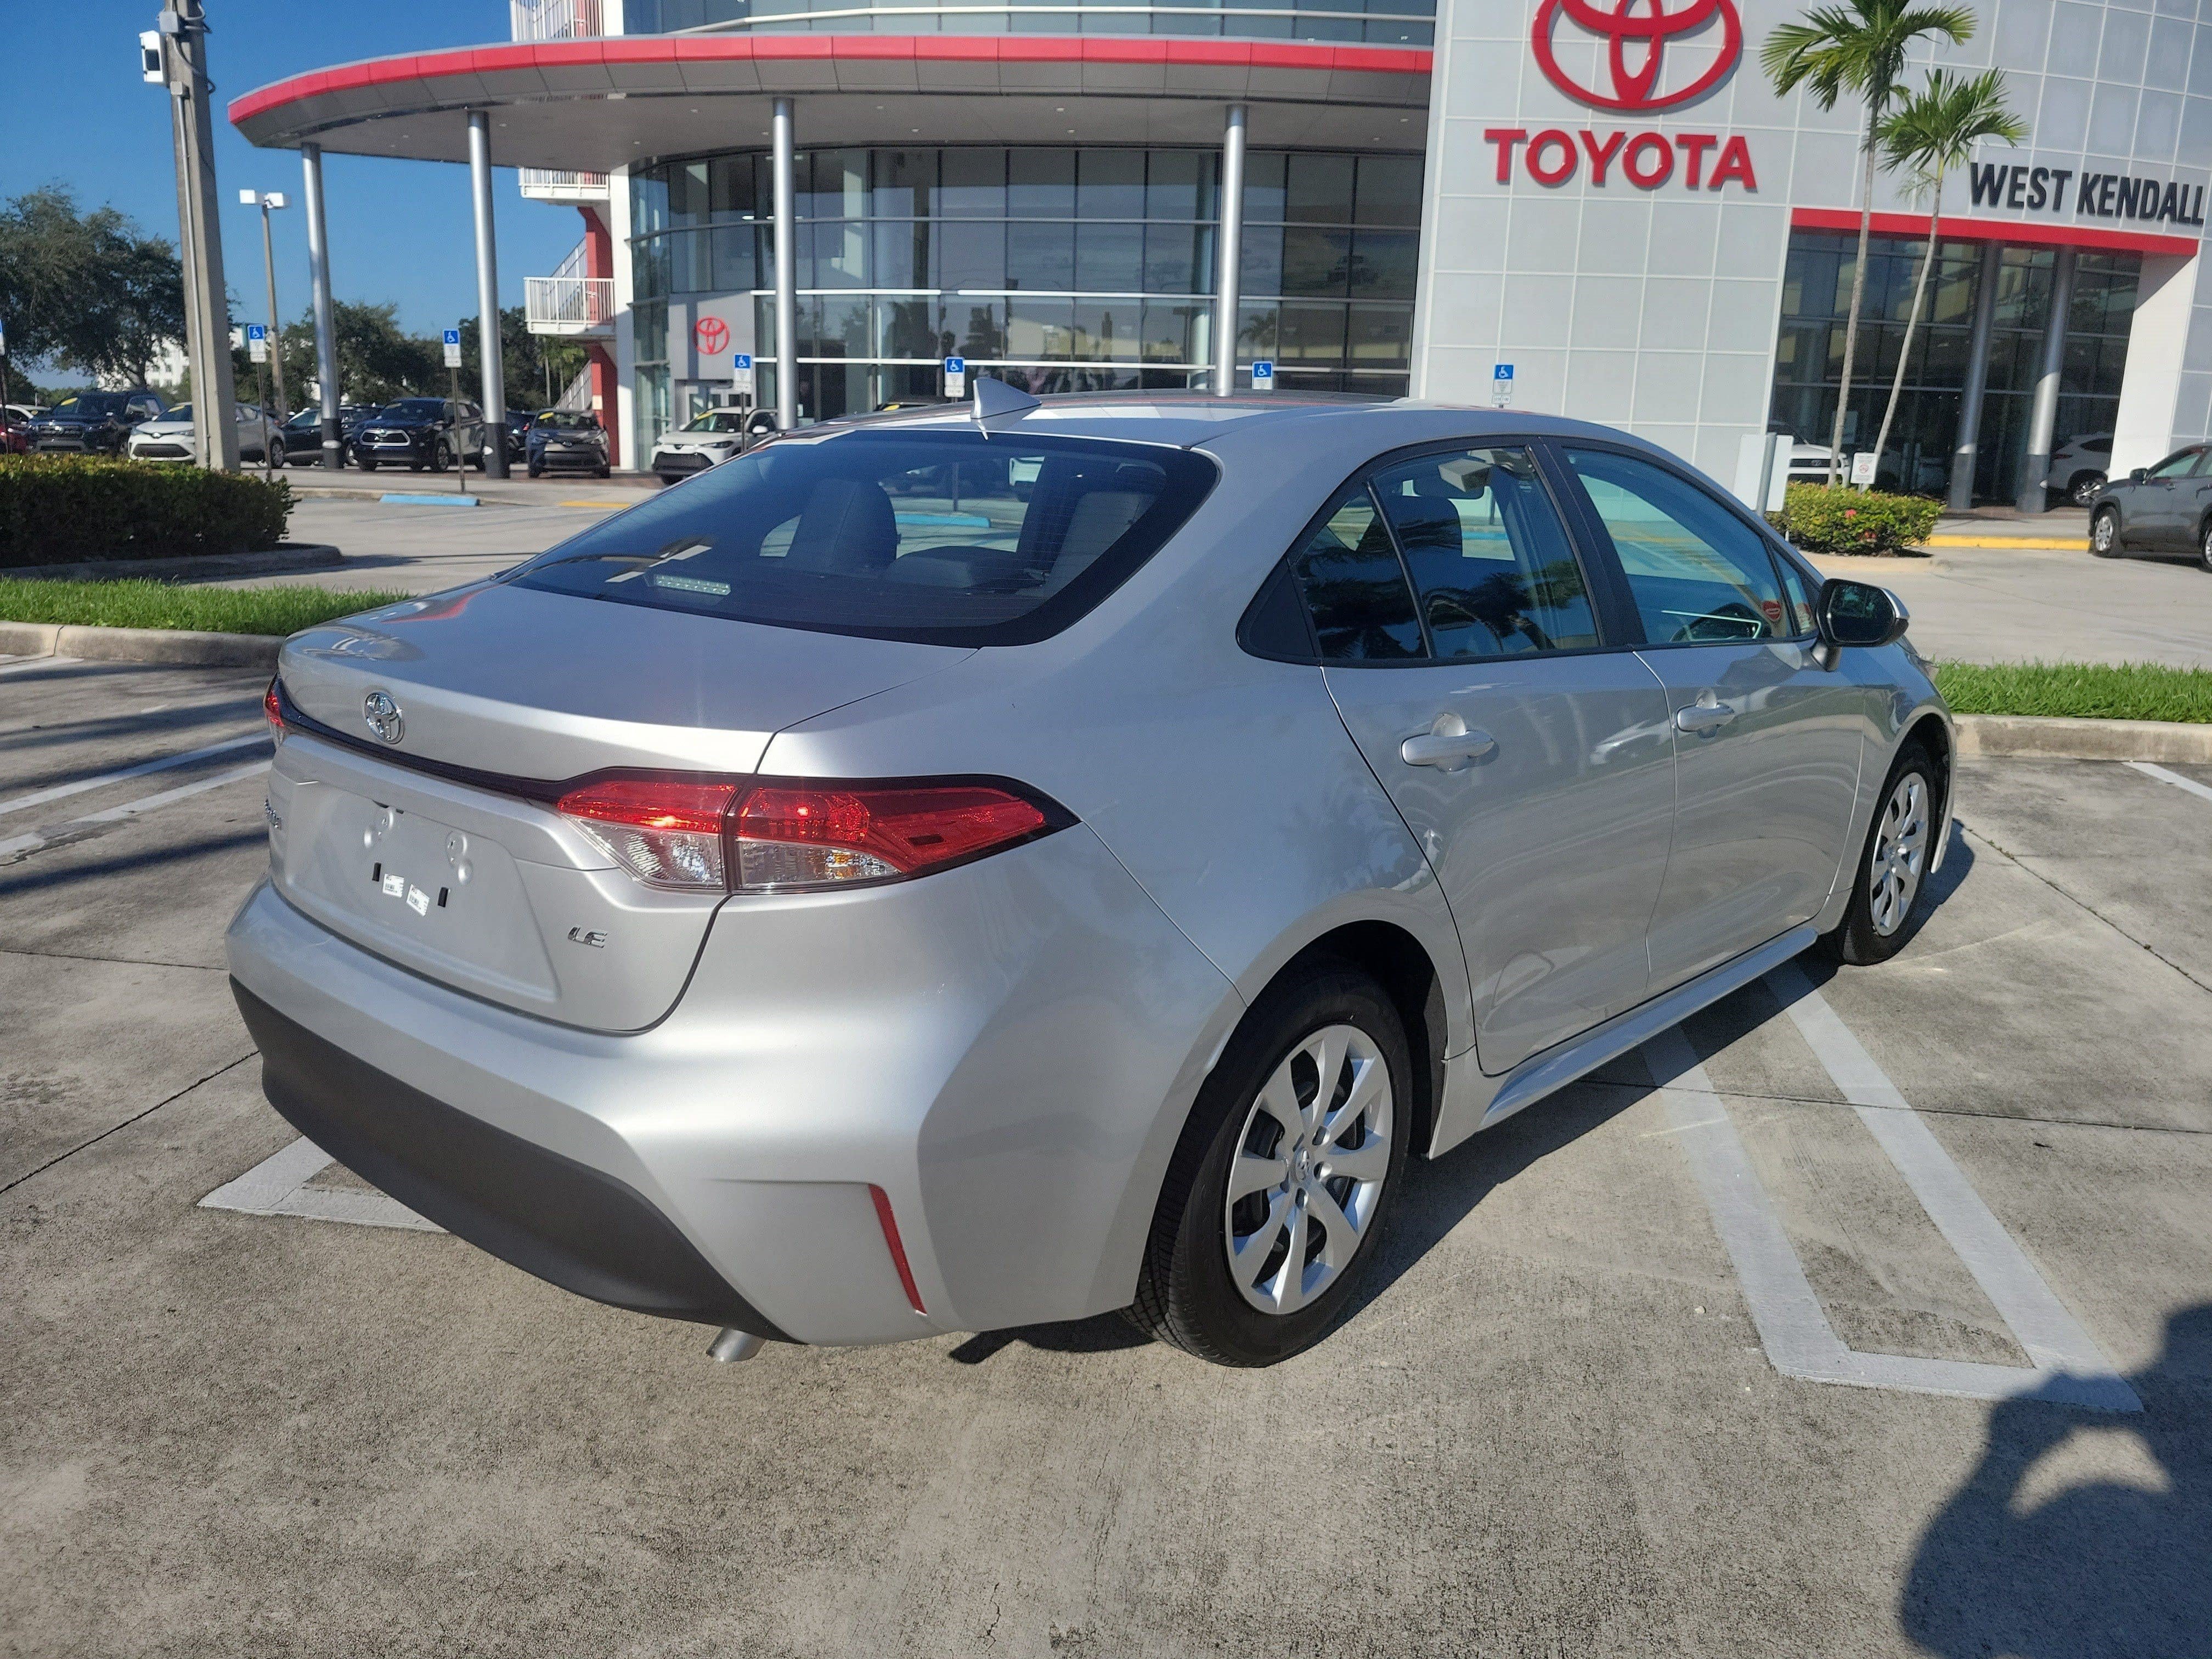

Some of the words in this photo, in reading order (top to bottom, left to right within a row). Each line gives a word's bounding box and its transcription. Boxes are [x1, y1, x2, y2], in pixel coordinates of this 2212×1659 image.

[1484, 128, 1758, 192] TOYOTA
[1970, 162, 2073, 213] WEST
[2076, 172, 2205, 225] KENDALL
[567, 926, 608, 949] LE
